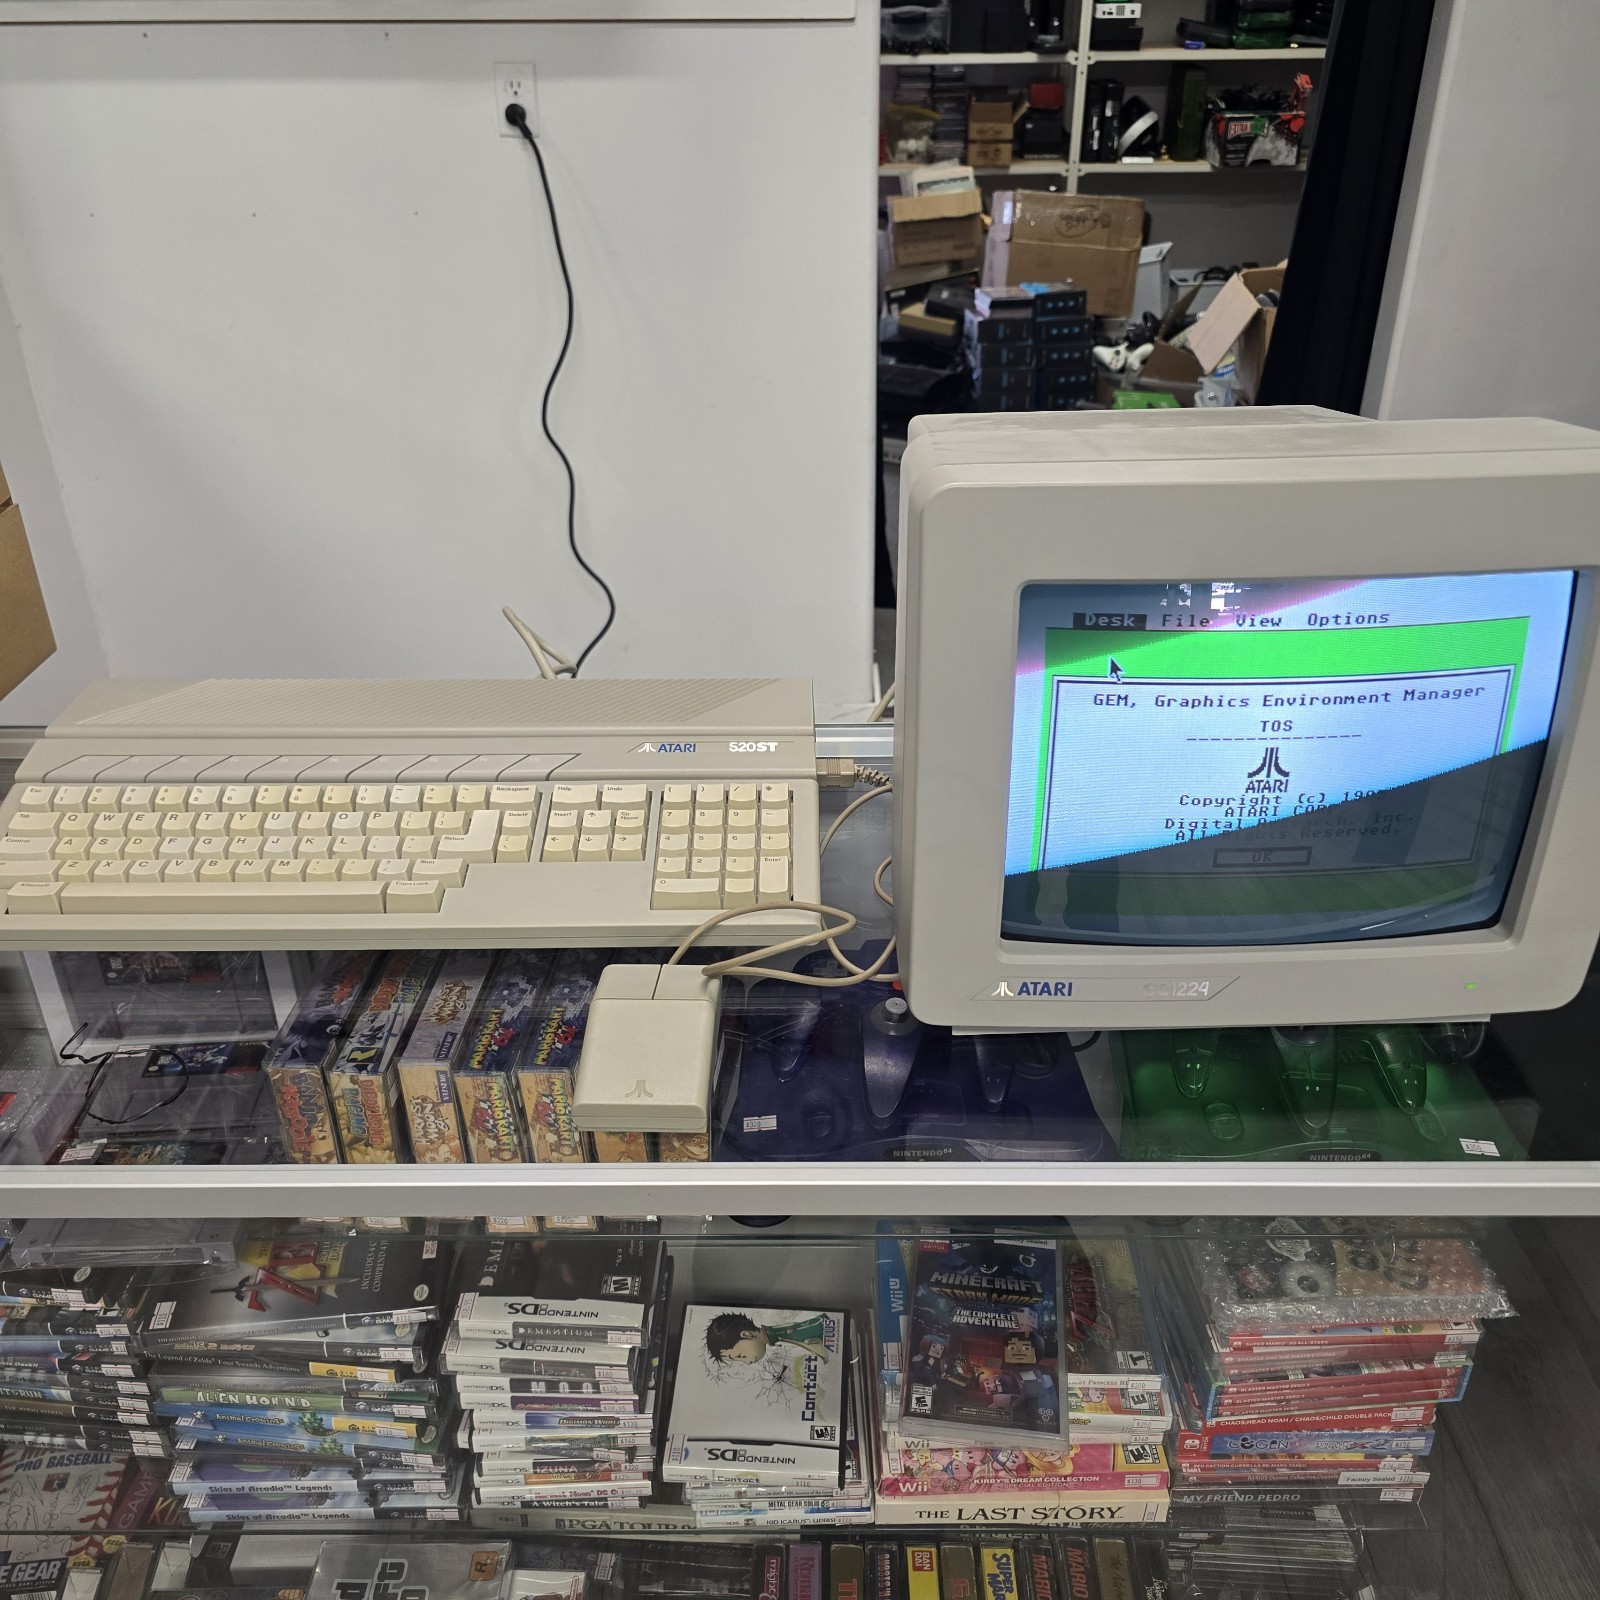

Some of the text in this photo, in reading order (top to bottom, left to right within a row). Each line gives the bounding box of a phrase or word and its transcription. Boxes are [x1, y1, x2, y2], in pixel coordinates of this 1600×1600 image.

[1085, 610, 1390, 627] Desk File View Options
[1093, 684, 1486, 710] GEM, Graphics Environment Manager
[1260, 720, 1293, 732] TOS
[658, 743, 696, 753] ATARI
[729, 742, 778, 752] 520ST
[1245, 779, 1289, 793] ATARI
[1179, 794, 1282, 807] Copyright
[67, 814, 78, 822] Q
[169, 813, 179, 821] R
[204, 813, 213, 821] T
[1224, 806, 1279, 817] ATARI
[1165, 818, 1242, 831] Digital
[1175, 829, 1205, 841] All
[1300, 824, 1400, 839] Reserved.
[63, 838, 74, 846] A
[98, 838, 109, 846] S
[202, 837, 213, 845] G
[1017, 981, 1073, 997] ATARI
[469, 1008, 504, 1070] MARIO KART
[533, 1007, 566, 1066] MARIO KART
[343, 1087, 368, 1135] RACING
[358, 1079, 385, 1145] DIDDY KONG
[488, 1081, 515, 1151] MARIO KART
[551, 1078, 575, 1147] MARIO KART
[410, 1096, 429, 1145] HARVEST
[423, 1101, 440, 1141] MOON
[746, 1120, 761, 1128] $320
[361, 1250, 377, 1290] INCLUDES
[373, 1249, 388, 1292] COMPREND
[930, 1272, 1043, 1293] MINECRAFT
[538, 1304, 599, 1318] NINTENDO
[956, 1309, 1018, 1321] THE COMPLETE
[953, 1315, 1020, 1329] ADVENTURE
[518, 1327, 593, 1337] DEMENTIUM
[823, 1318, 836, 1352] ATLUS
[526, 1340, 586, 1354] NINTENDO
[158, 1354, 182, 1363] Legend
[802, 1355, 818, 1422] Contact
[197, 1392, 239, 1404] ALIEN
[215, 1414, 285, 1425] Animal Crossing
[237, 1438, 265, 1446] Animal
[904, 1439, 931, 1448] Wii
[1228, 1437, 1289, 1450] COGEN
[14, 1453, 112, 1472] PRO BASEBALL
[738, 1448, 796, 1465] NINTENDO
[717, 1475, 761, 1484] Contact
[973, 1476, 1100, 1485] KIRBY'S DREAM COLLECTION
[296, 1484, 333, 1492] Legends
[899, 1481, 929, 1493] Wii
[541, 1500, 582, 1508] Witch's
[1183, 1494, 1203, 1503] MY
[1206, 1494, 1254, 1502] FRIEND
[312, 1512, 350, 1520] Legends
[915, 1504, 1122, 1521] THE LAST STORY
[567, 1517, 678, 1531] PGA TOUR
[914, 1550, 922, 1568] DAI
[922, 1550, 931, 1571] BAN
[11, 1560, 62, 1582] GEAR
[993, 1552, 1014, 1594] SUPER
[1067, 1548, 1089, 1598] MARIO
